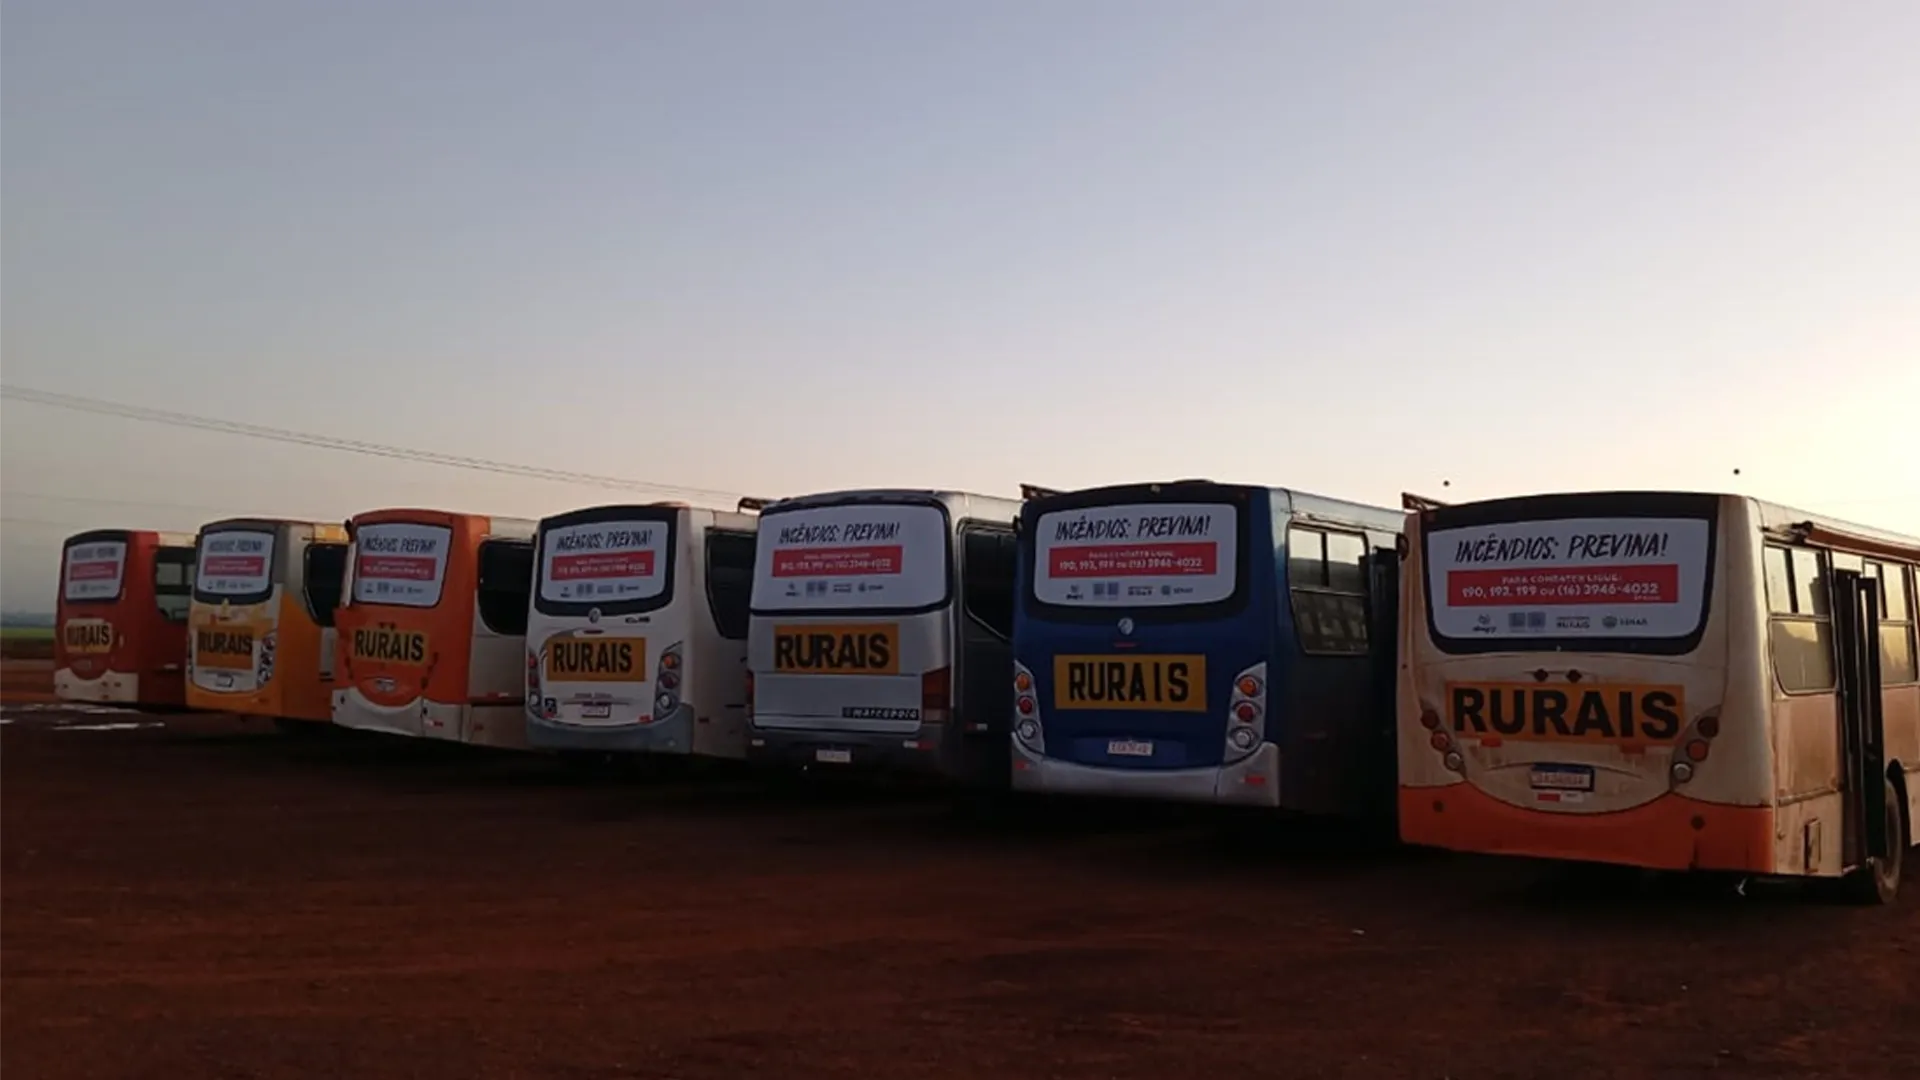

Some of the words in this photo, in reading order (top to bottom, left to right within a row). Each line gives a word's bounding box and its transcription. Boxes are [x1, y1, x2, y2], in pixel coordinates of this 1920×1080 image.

[1055, 516, 1132, 541] INCÊNDIOS:
[1137, 515, 1211, 538] PREVINA!
[1455, 534, 1559, 563] INCÊNDIOS:
[1567, 533, 1668, 560] PREVINA!
[1557, 583, 1581, 596] (16)
[1584, 582, 1659, 595] 3946-4032
[355, 630, 424, 661] RURAIS
[553, 642, 632, 673] RURAIS
[775, 633, 889, 668] RURAIS
[1068, 661, 1189, 702] RURAIS
[1453, 687, 1680, 739] RURAIS
